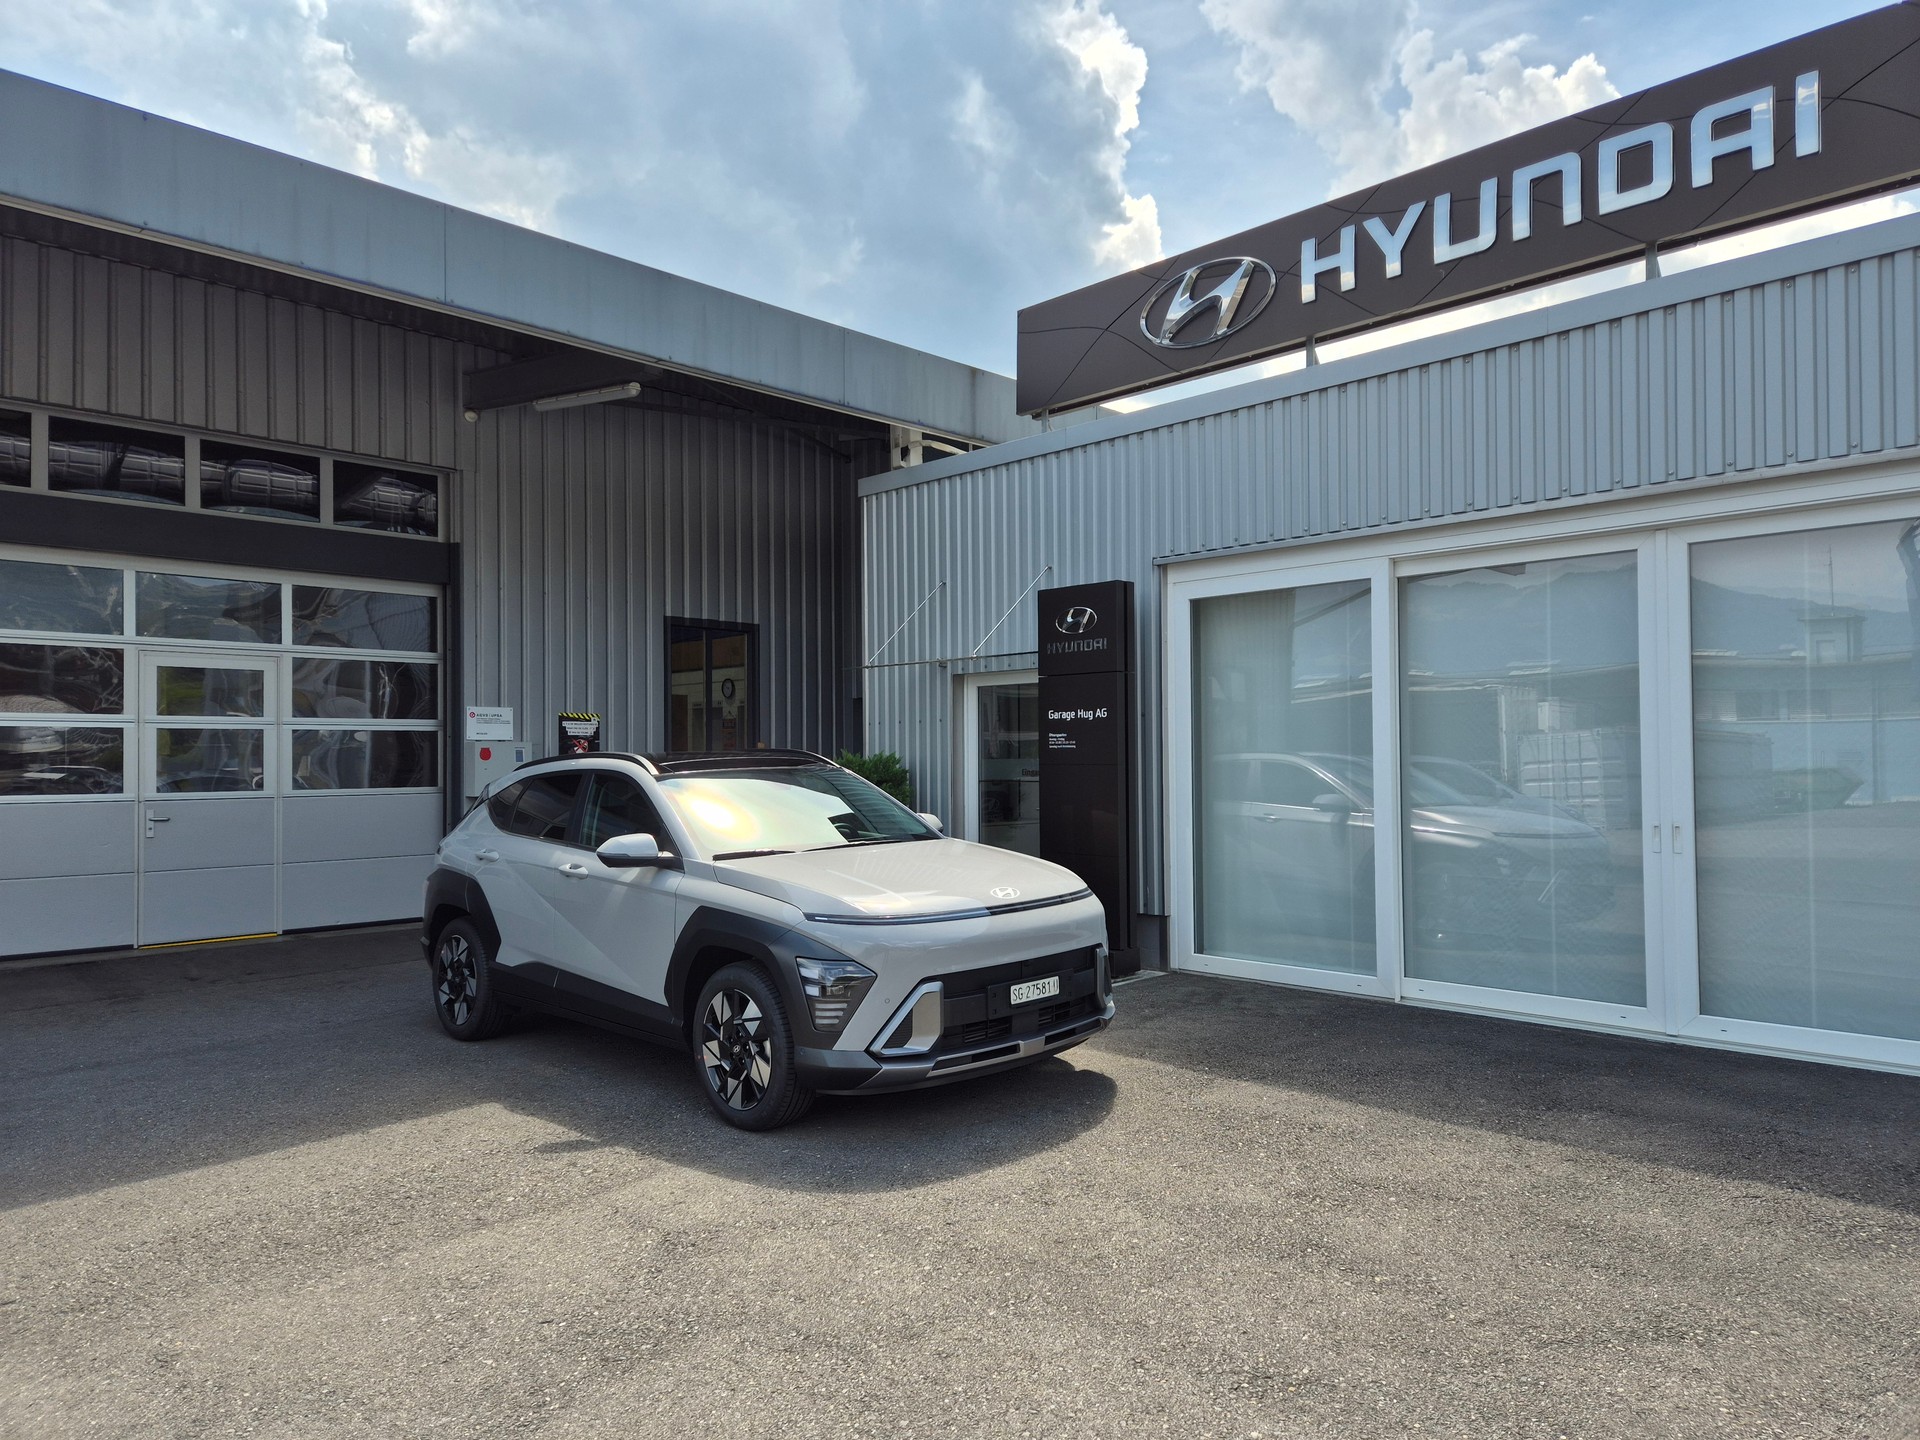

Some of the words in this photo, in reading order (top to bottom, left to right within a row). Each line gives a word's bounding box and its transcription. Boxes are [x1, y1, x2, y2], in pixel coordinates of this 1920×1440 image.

[1301, 70, 1821, 304] HYUNDAI
[1047, 637, 1107, 654] HYUNDAI
[1048, 710, 1076, 721] Garage
[1077, 709, 1094, 720] Hug
[1095, 708, 1108, 718] AG
